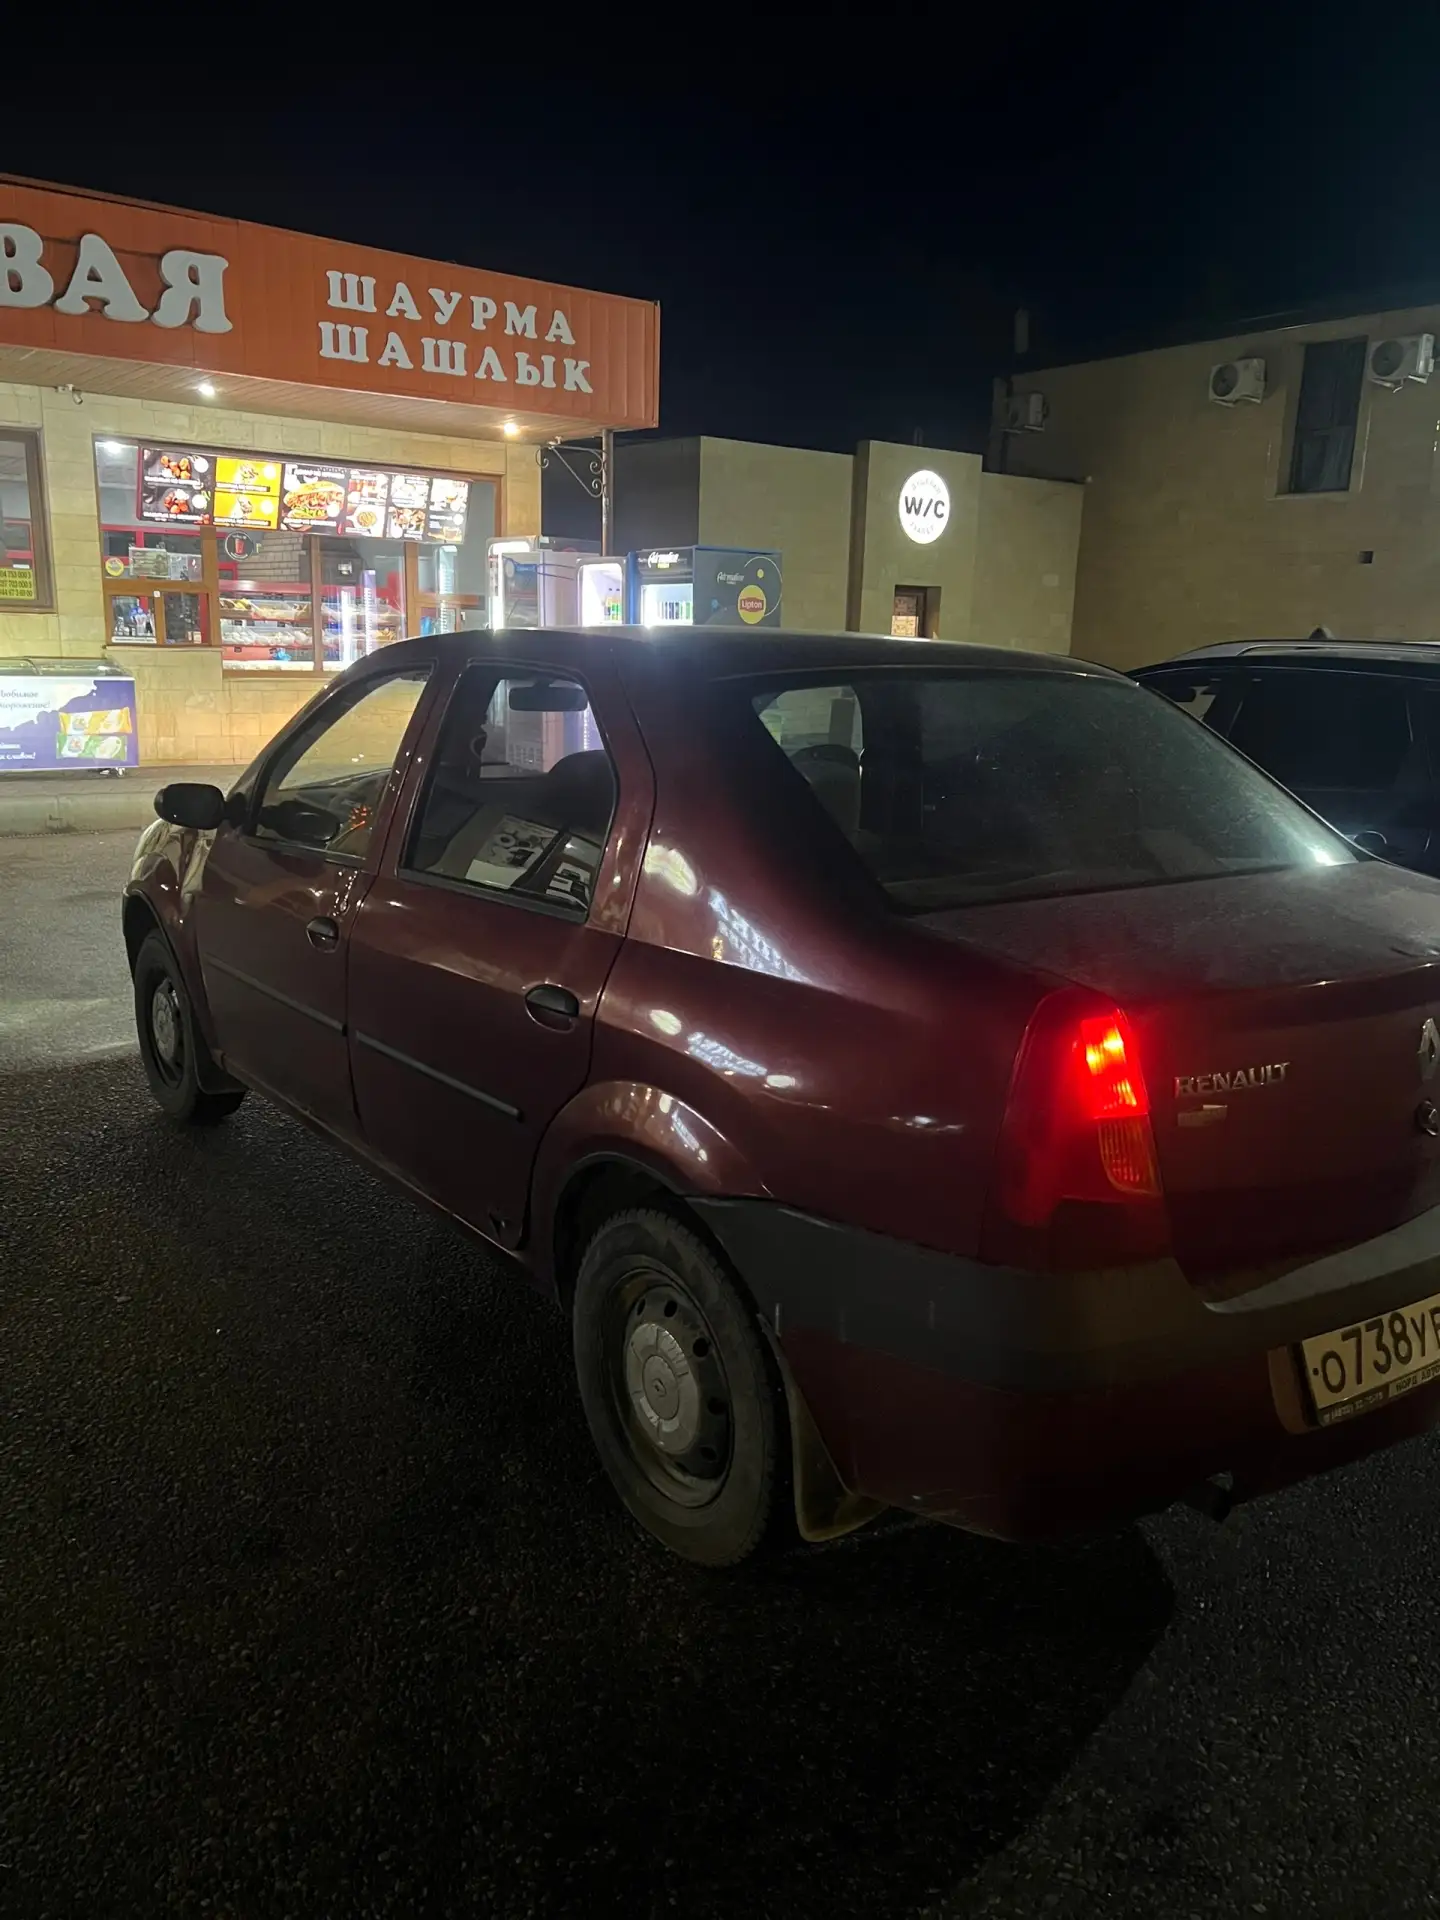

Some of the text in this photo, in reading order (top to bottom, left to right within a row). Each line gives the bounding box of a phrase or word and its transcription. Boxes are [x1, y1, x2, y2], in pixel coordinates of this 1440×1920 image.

[326, 270, 576, 346] ШАУРМА
[318, 321, 594, 394] ШАШЛЫК
[904, 495, 945, 519] W/C
[741, 600, 763, 609] Lipton
[1174, 1062, 1291, 1099] RENAULT
